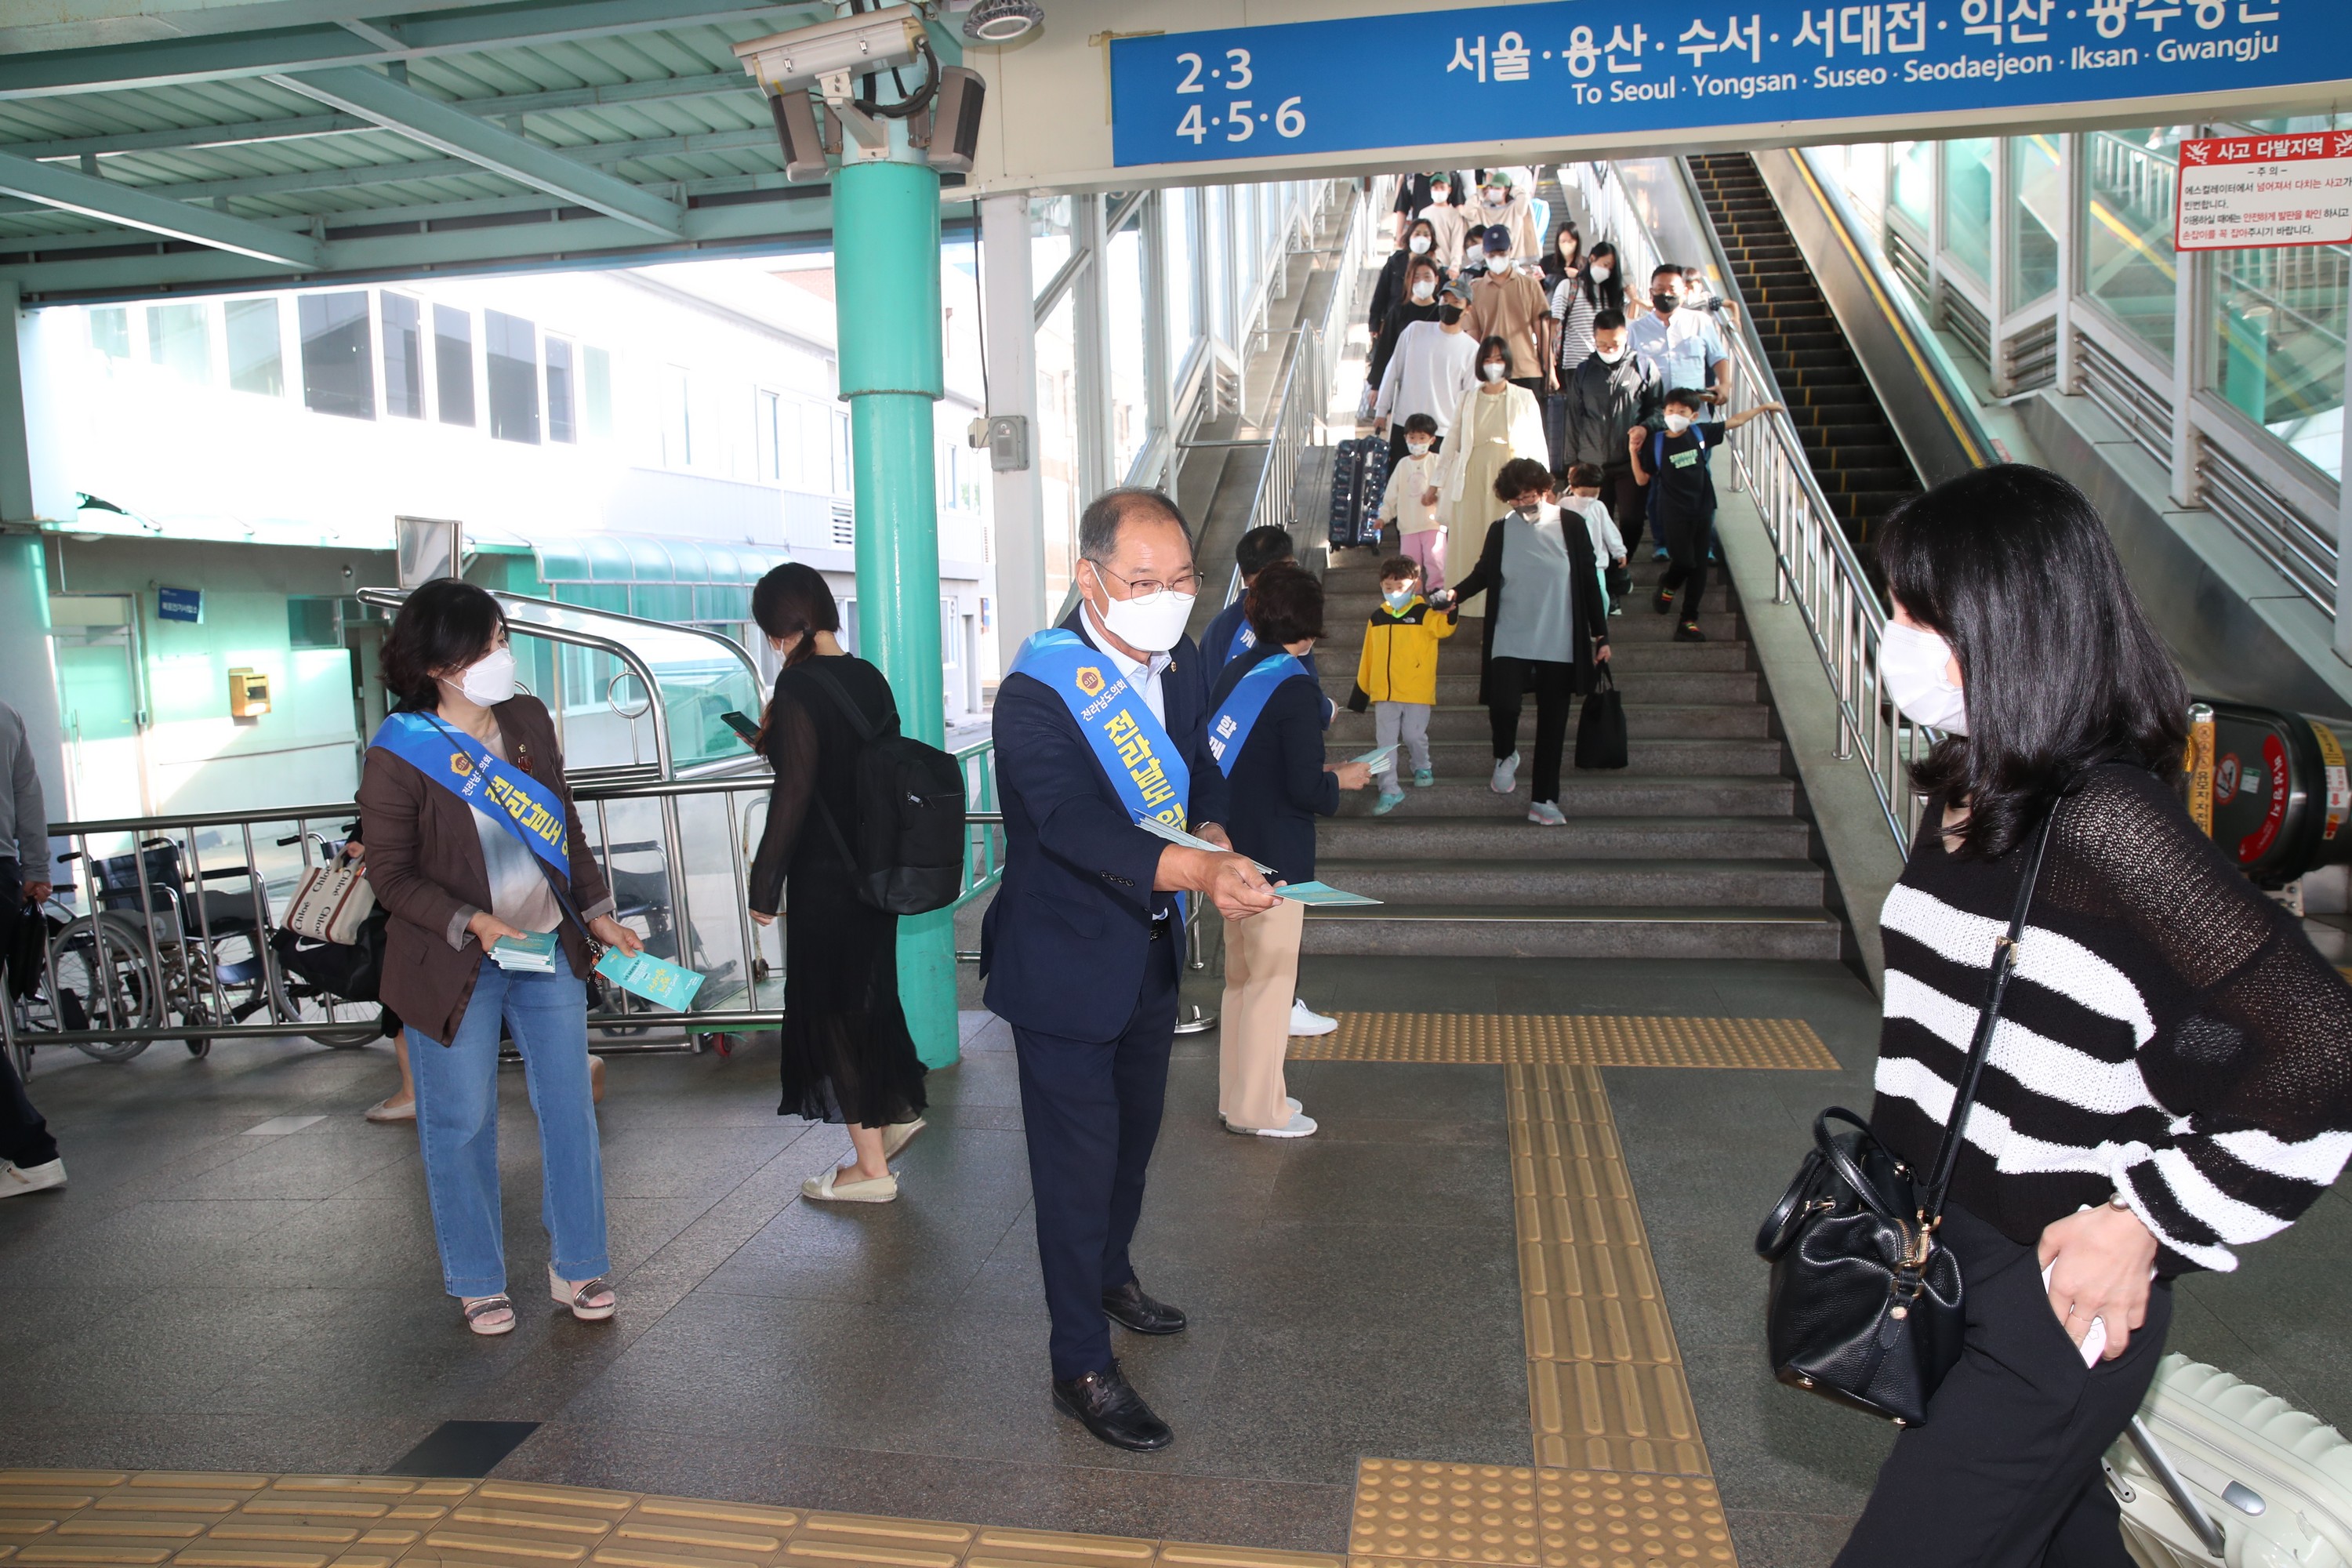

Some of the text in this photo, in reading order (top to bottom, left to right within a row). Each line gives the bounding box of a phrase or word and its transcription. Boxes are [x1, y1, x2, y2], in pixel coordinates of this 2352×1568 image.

[1447, 31, 1530, 83] 서울
[1562, 24, 1647, 78] 용산
[1677, 15, 1760, 67] 수서
[1792, 2, 1926, 58] 서대전
[1961, 0, 2055, 45] 익산
[1571, 31, 2278, 104] To Seoul Yongsan Suseo Seodaejeon Iksan Gwangju
[2217, 137, 2323, 160] 사고 다발지역
[2185, 183, 2253, 195] 에스컬레이터에서
[2295, 179, 2321, 189] 다치는
[2325, 176, 2352, 188] 사고가
[2183, 215, 2215, 225] 이용하실
[2243, 211, 2276, 223] 안전하게
[2278, 209, 2302, 221] 발판을
[2305, 209, 2321, 220] 확인
[2324, 208, 2349, 218] 하시고
[2183, 229, 2216, 240] 손잡이를
[2276, 224, 2314, 236] 바랍니다.
[1084, 673, 1097, 687] 의회
[1080, 678, 1128, 722] 전라남도의회
[1103, 708, 1176, 808] 전라남도
[294, 902, 310, 930] Chloé
[315, 906, 331, 935] Chloé
